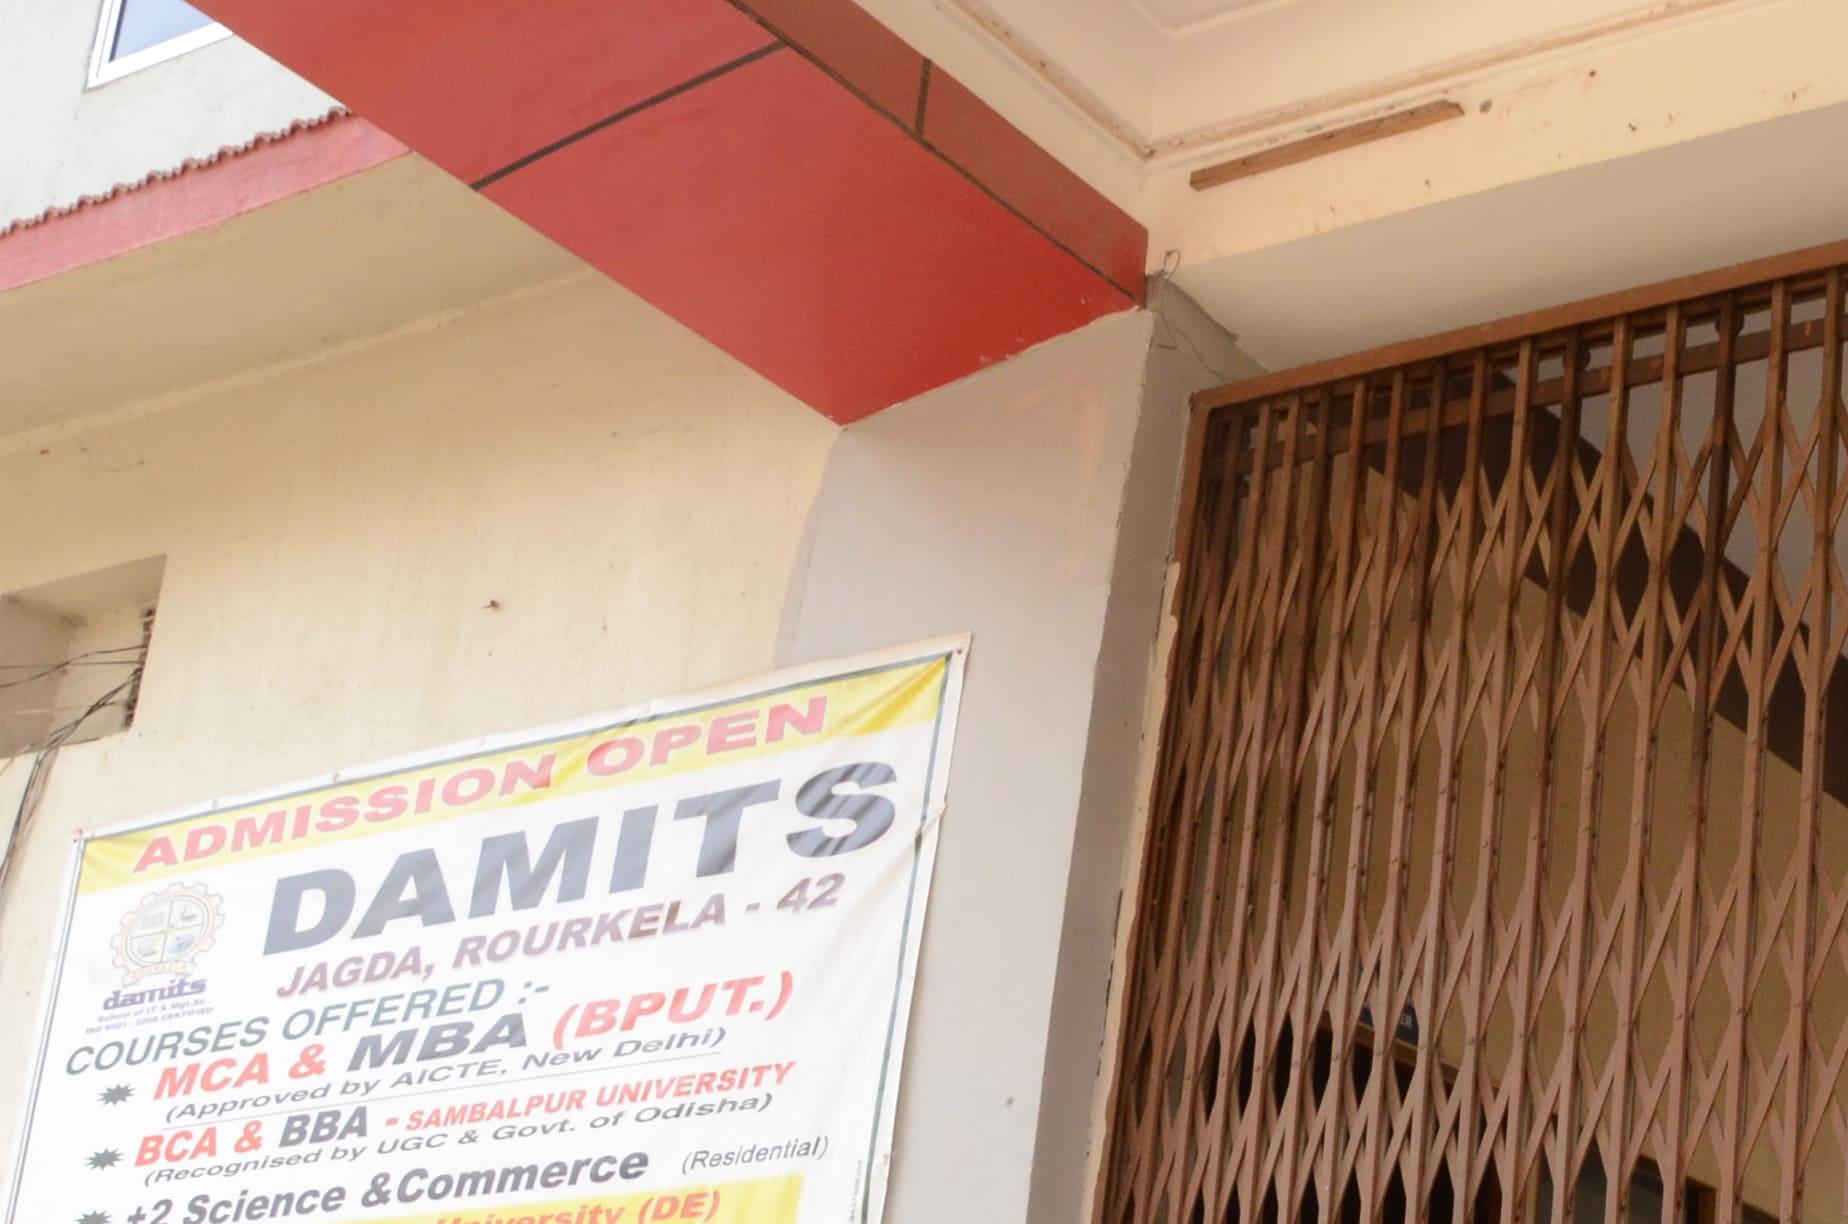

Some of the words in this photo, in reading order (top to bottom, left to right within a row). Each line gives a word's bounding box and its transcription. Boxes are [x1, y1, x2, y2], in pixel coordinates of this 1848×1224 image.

[132, 753, 556, 873] ADMISSION
[586, 695, 828, 777] OPEN
[262, 761, 897, 956] DAMITS
[276, 945, 434, 999] JAGDA,
[452, 893, 727, 969] ROURKELA
[776, 872, 846, 914] 42
[65, 1016, 270, 1076] COURSES
[282, 978, 505, 1040] OFFERED
[103, 978, 207, 1010] damits
[153, 1052, 269, 1100] MCA
[288, 1043, 326, 1079] &
[347, 1012, 527, 1072] MBA
[553, 970, 793, 1050] (BPUT.)
[134, 1126, 217, 1167] BCA
[233, 1120, 263, 1153] &
[278, 1106, 368, 1148] BBA
[405, 1088, 587, 1132] SAMBALPUR
[596, 1061, 797, 1106] UNIVERSITY
[165, 1083, 332, 1123] (Approved
[339, 1077, 381, 1096] by
[390, 1058, 507, 1089] AICTE,
[522, 1050, 602, 1070] New
[613, 1026, 727, 1058] Delhi)
[144, 1148, 322, 1188] (Recognised
[330, 1144, 367, 1163] by
[377, 1133, 449, 1155] UGC
[457, 1129, 479, 1145] &
[491, 1118, 575, 1141] Govt.
[589, 1110, 627, 1129] of
[634, 1093, 772, 1123] Odisha)
[682, 1136, 829, 1175] (Residential)
